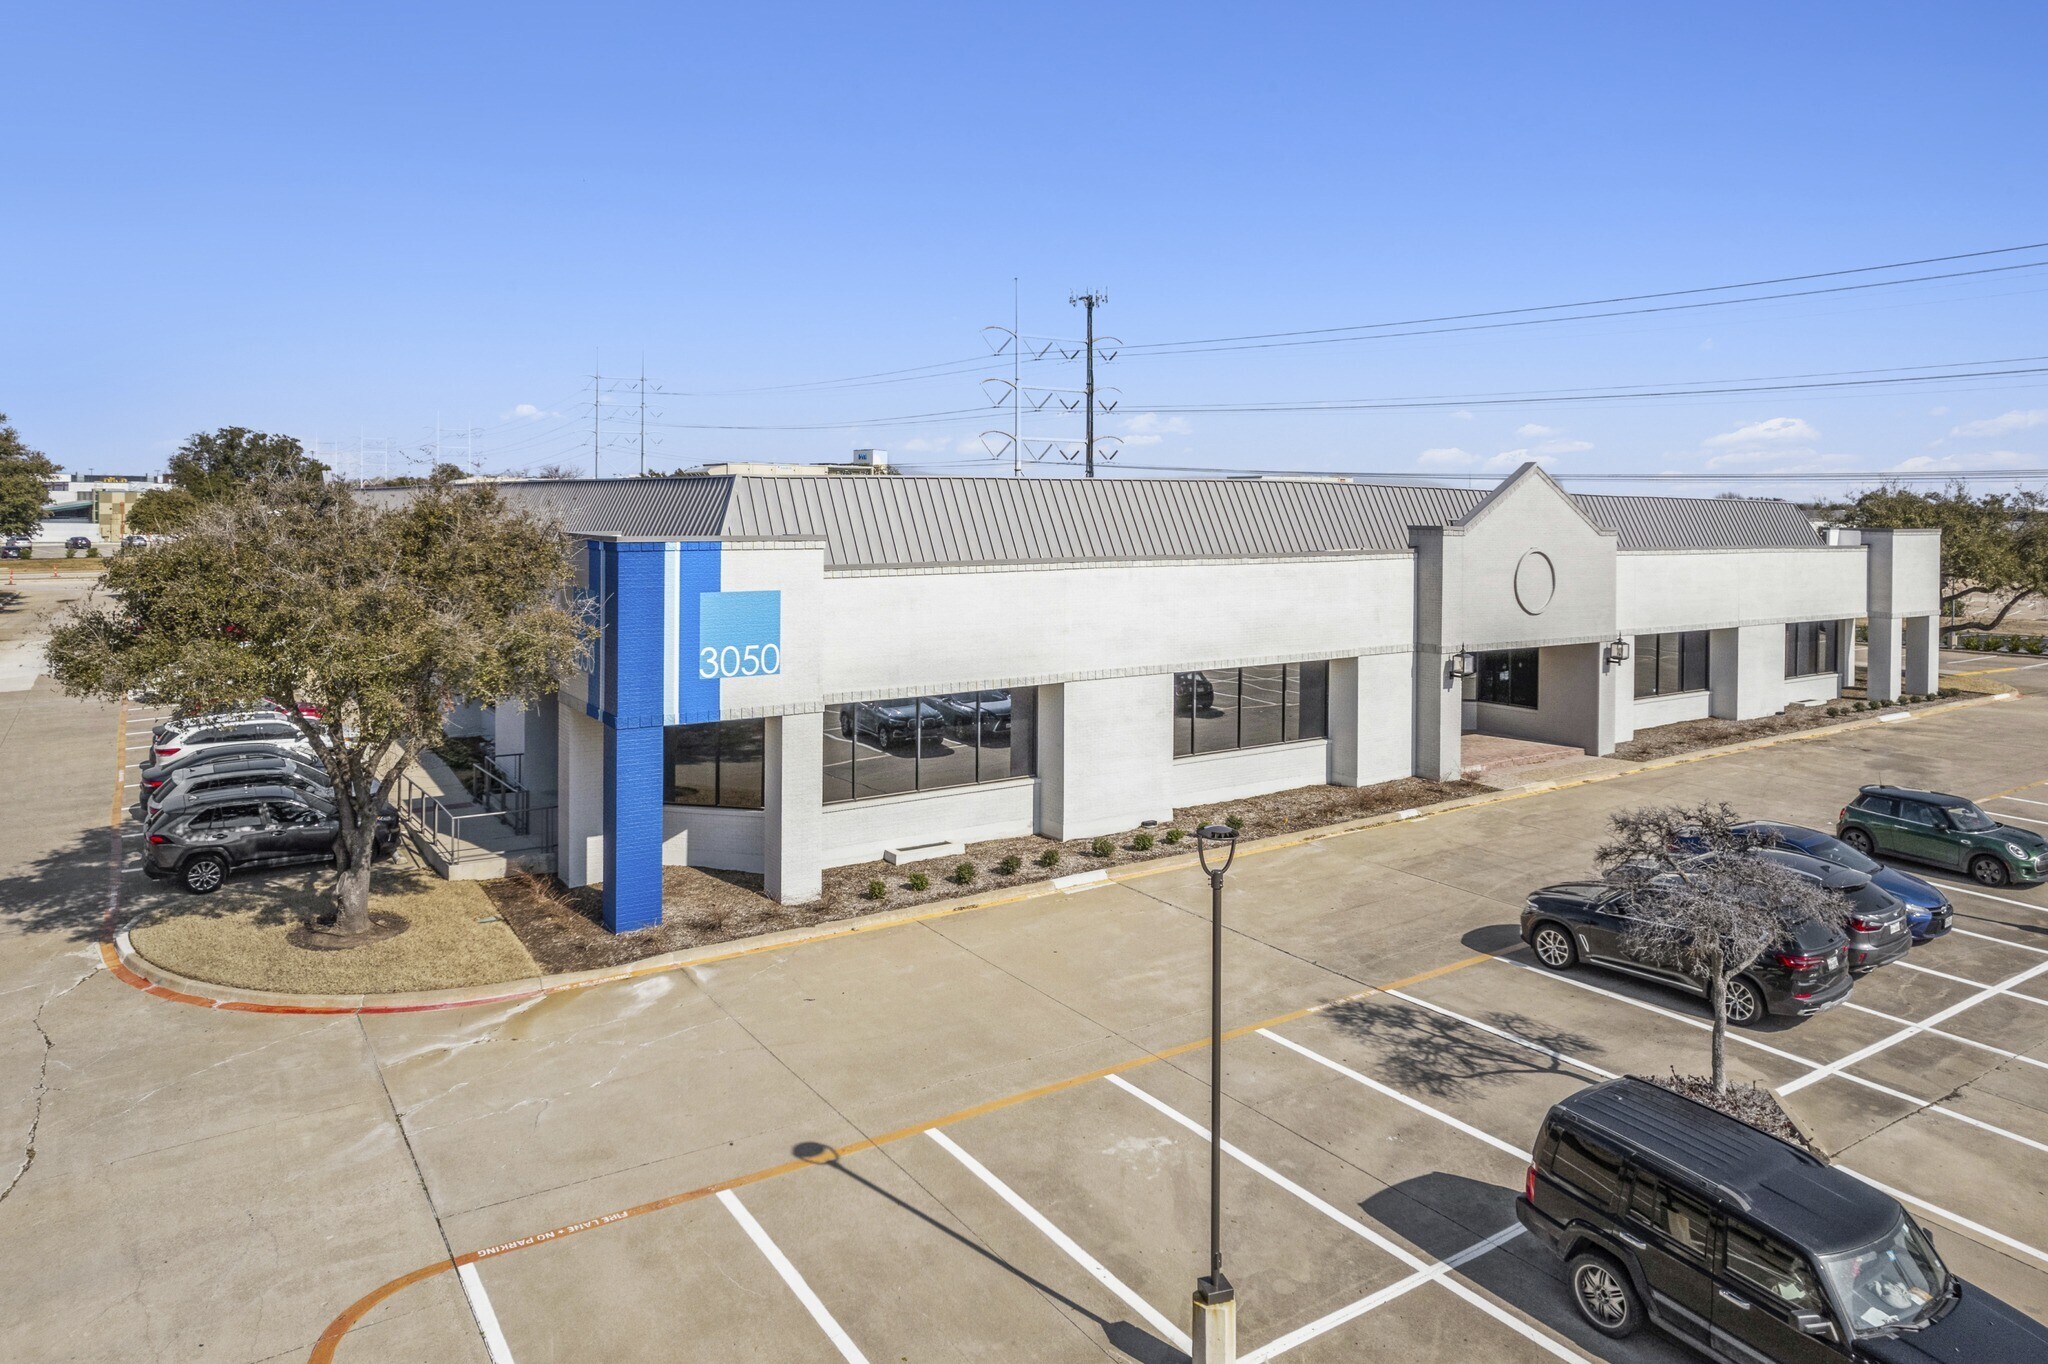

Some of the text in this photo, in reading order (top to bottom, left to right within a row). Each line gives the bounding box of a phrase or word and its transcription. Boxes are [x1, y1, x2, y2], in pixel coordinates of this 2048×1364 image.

[699, 643, 780, 679] 3050
[477, 1211, 628, 1258] FIRE LANE NO PARKING
